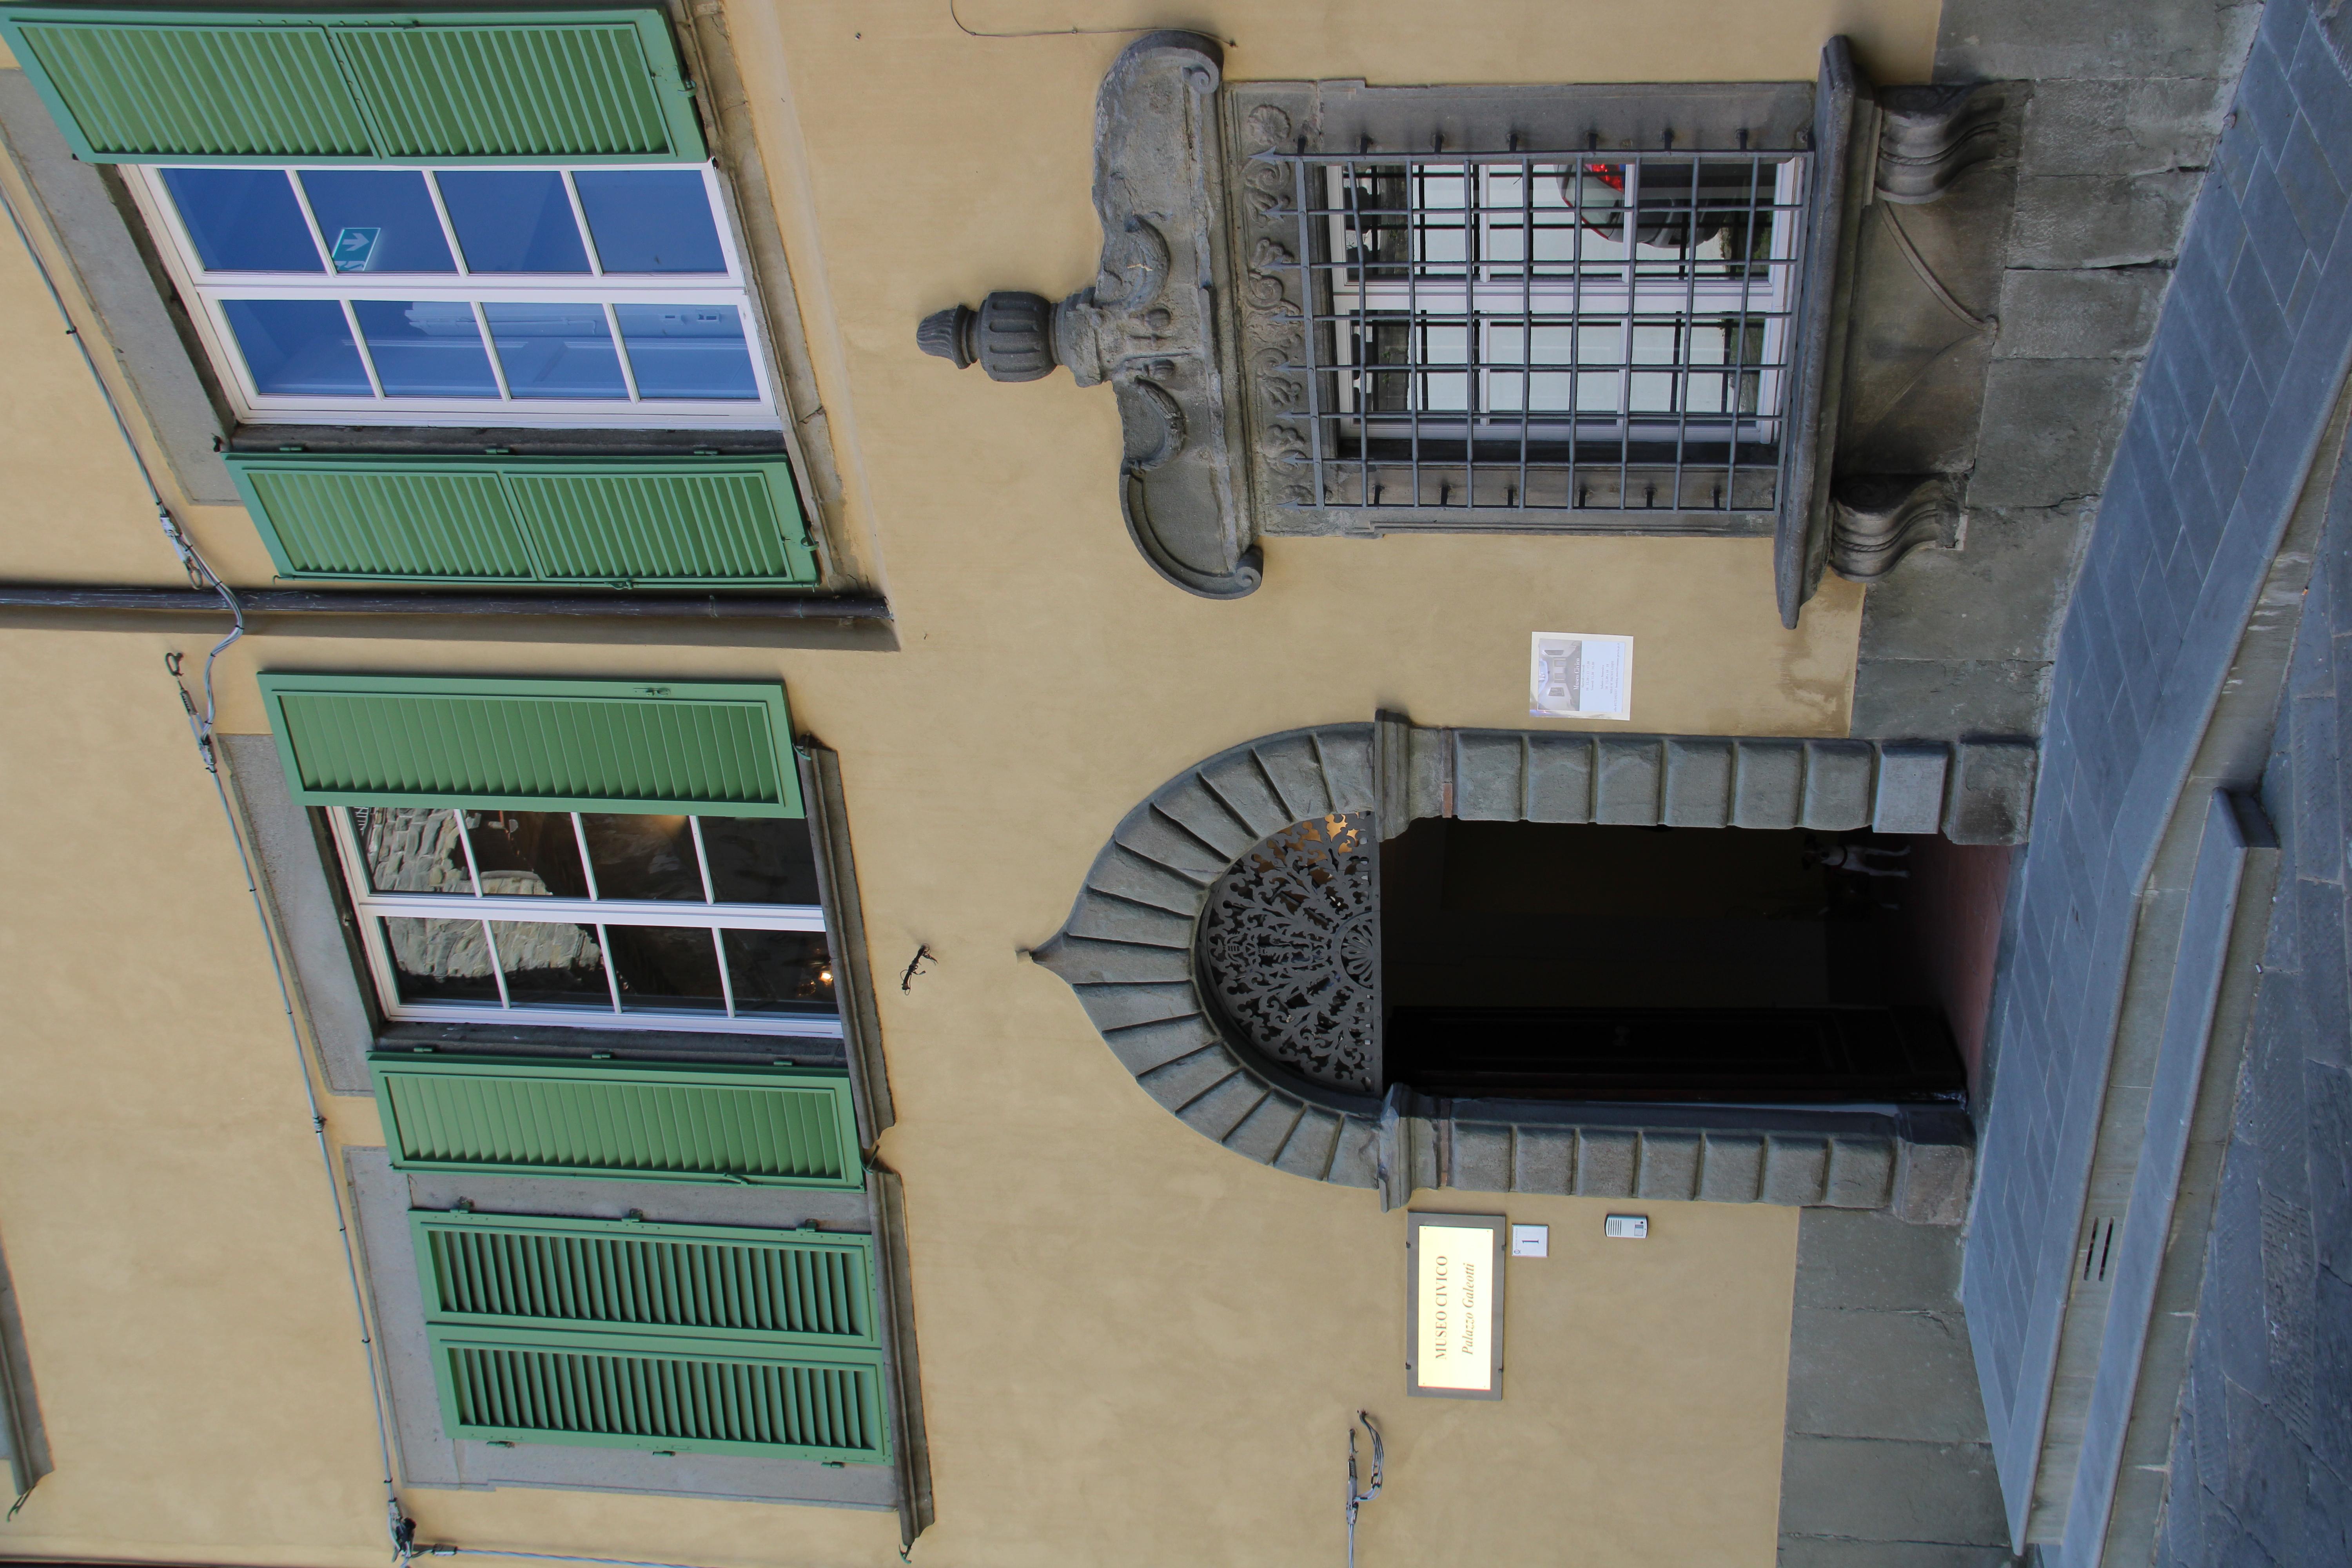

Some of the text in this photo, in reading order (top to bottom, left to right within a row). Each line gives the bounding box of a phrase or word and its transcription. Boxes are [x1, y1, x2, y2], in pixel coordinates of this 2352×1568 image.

[1435, 1255, 1448, 1359] MUSEO CIVICO
[1461, 1263, 1475, 1355] Palazzo Galeotti
